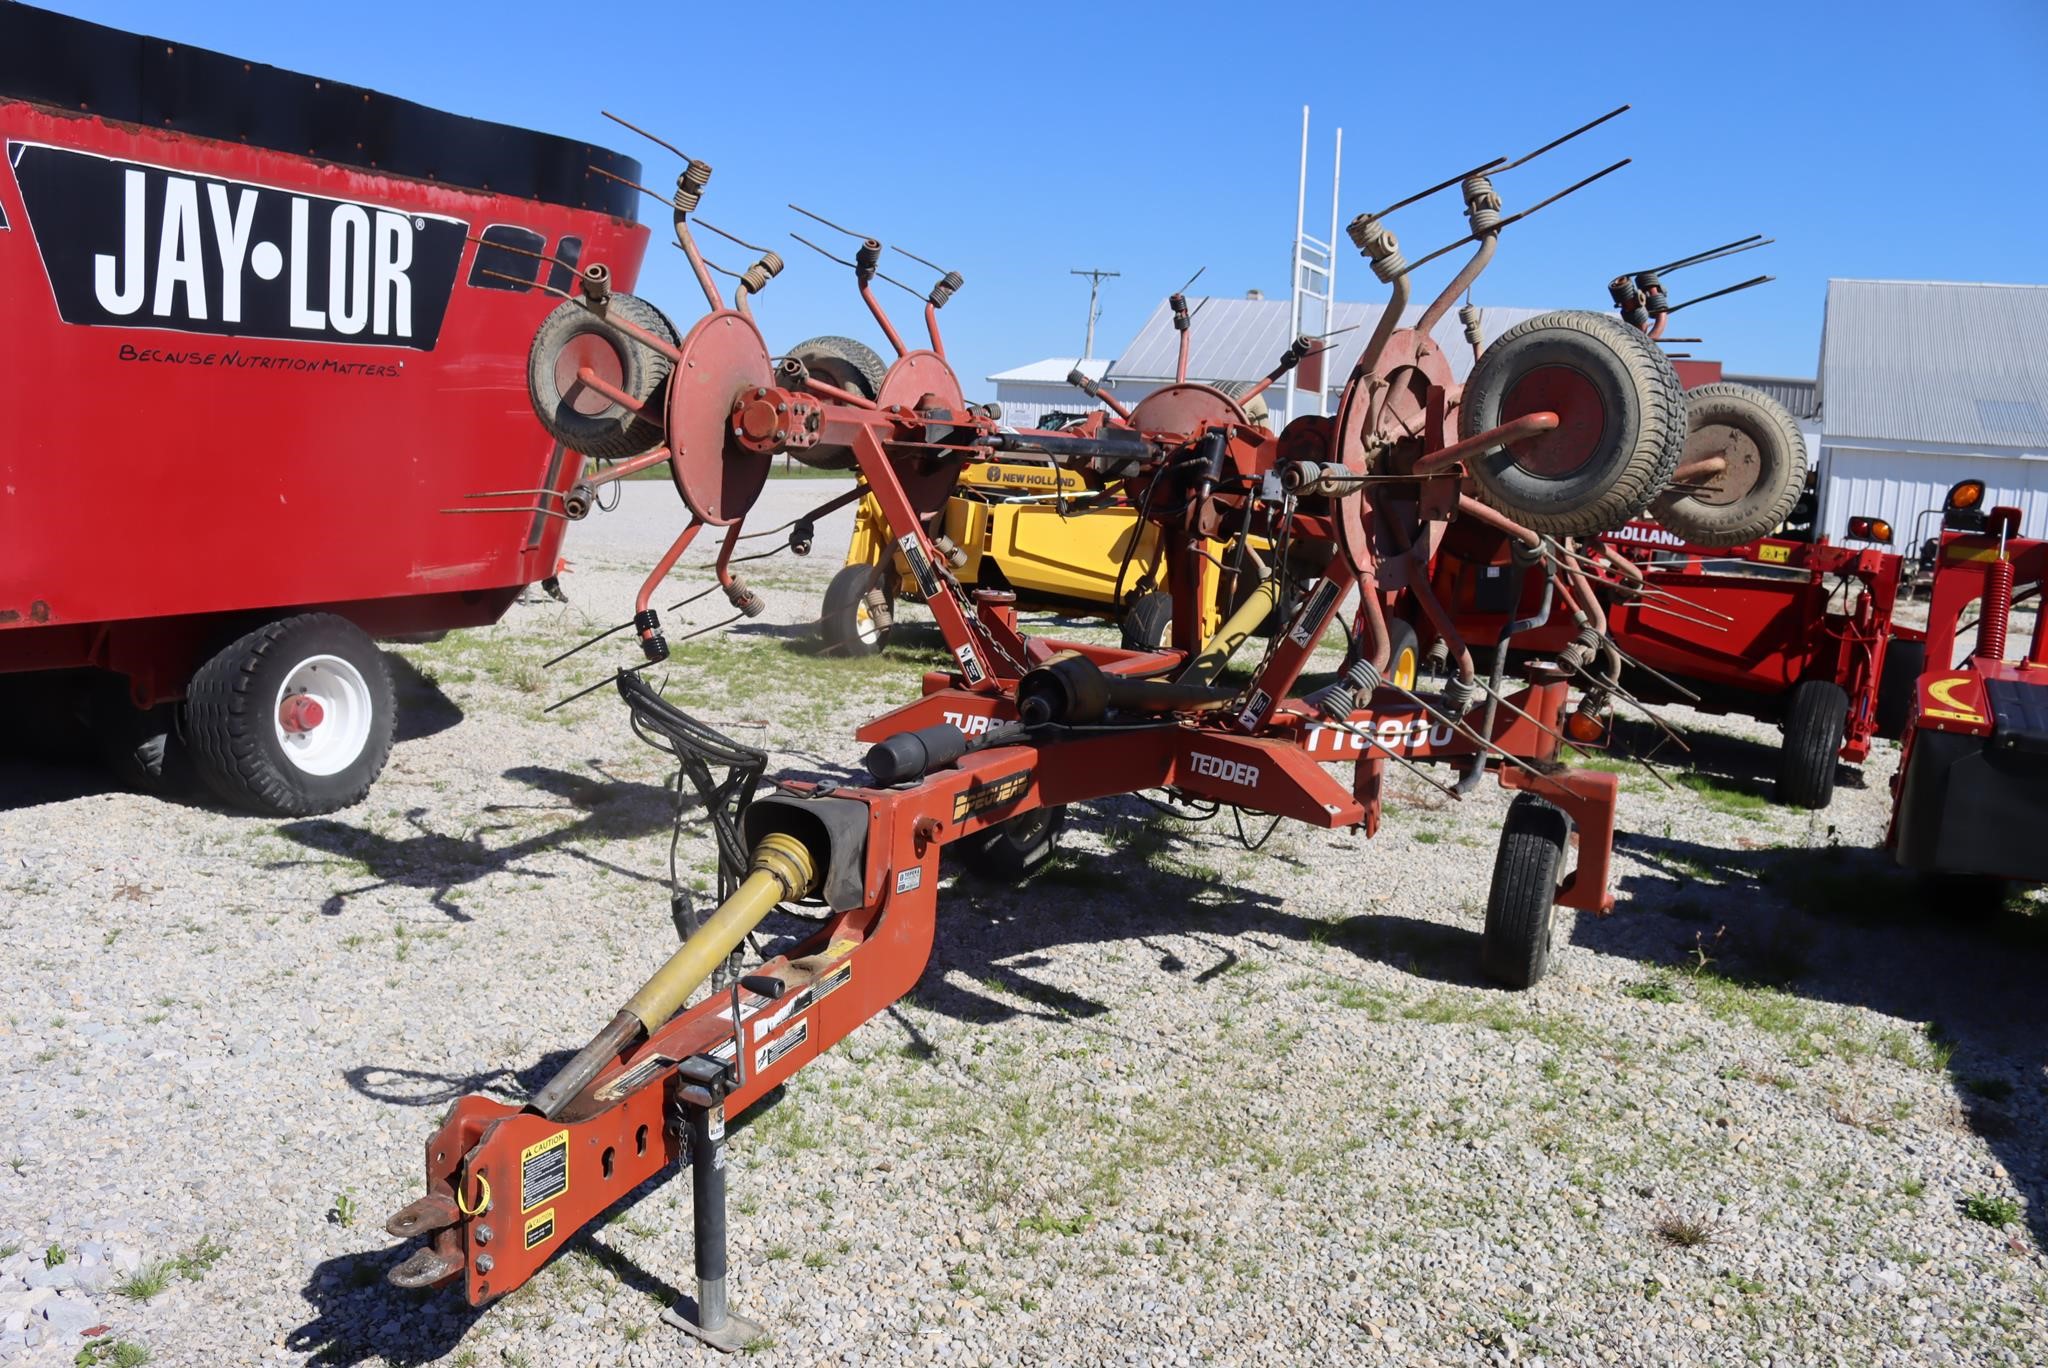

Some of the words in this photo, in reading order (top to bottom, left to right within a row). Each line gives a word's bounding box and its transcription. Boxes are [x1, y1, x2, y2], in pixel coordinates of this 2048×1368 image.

[220, 350, 319, 373] NUTRITION
[1002, 473, 1025, 483] NEW
[1190, 751, 1260, 788] TEDDER
[533, 1132, 564, 1154] CAUTION
